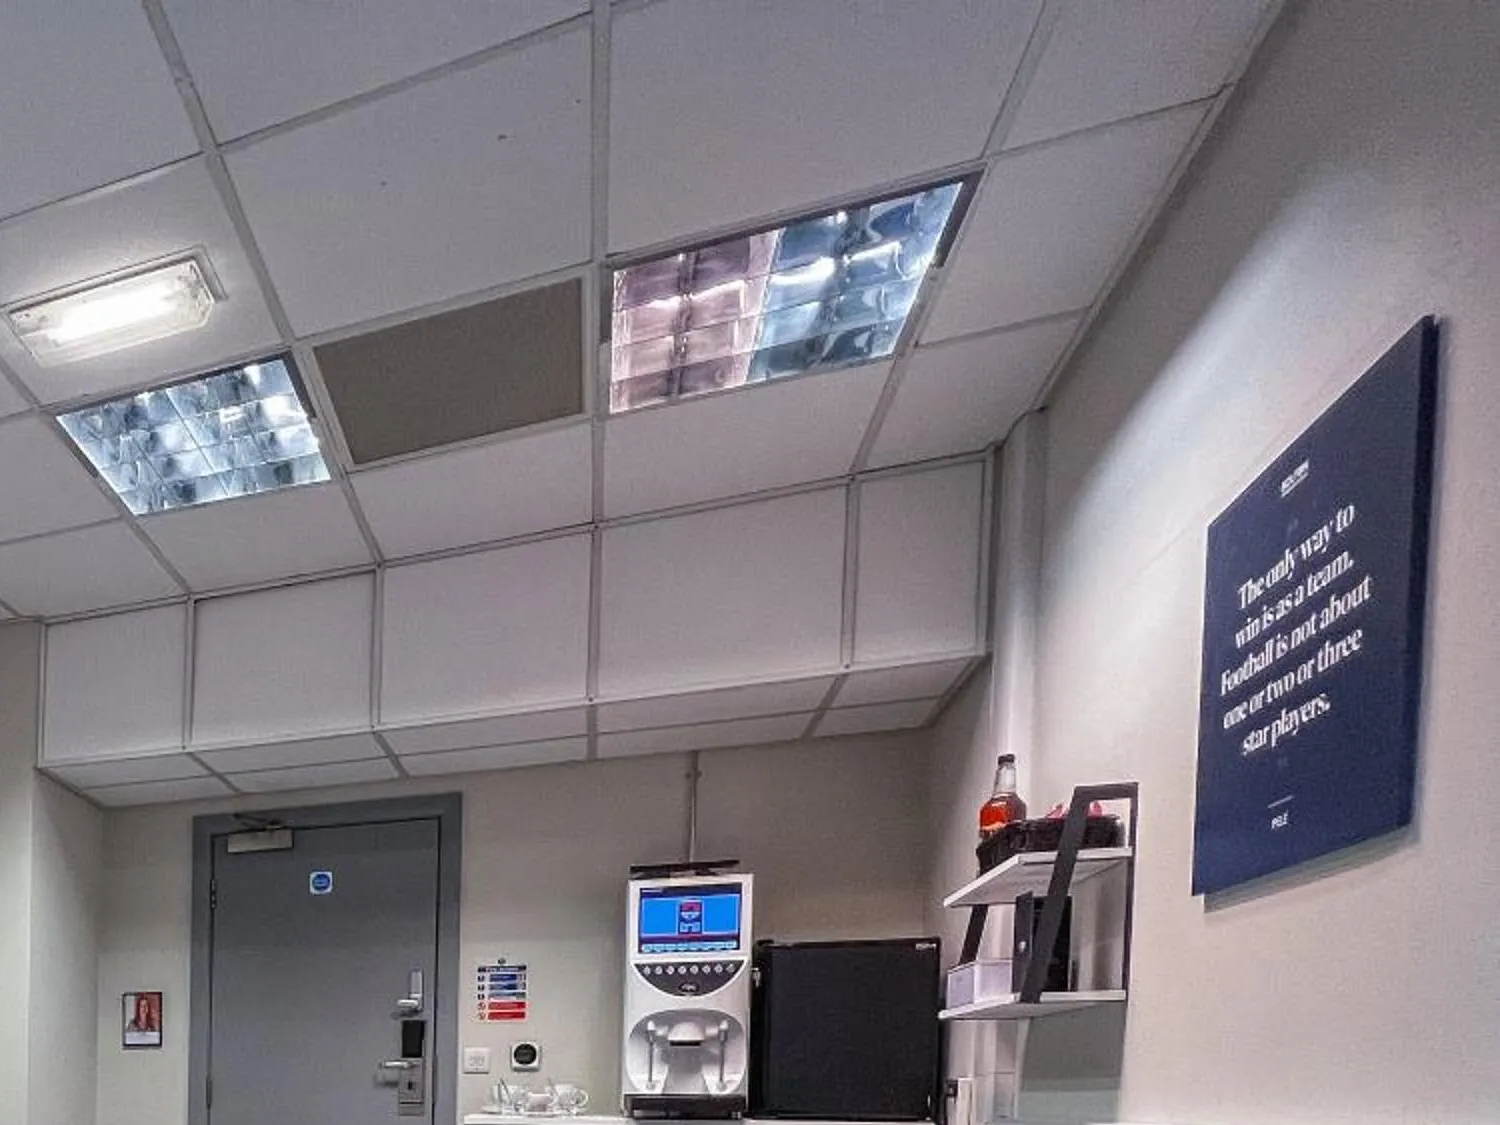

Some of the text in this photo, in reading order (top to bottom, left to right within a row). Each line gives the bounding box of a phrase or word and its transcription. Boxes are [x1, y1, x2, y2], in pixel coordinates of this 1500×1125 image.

[1235, 551, 1354, 649] win is as a team.
[1237, 505, 1354, 609] The only way to
[1220, 575, 1372, 696] Football is not about
[1223, 628, 1363, 729] one or two or three
[1243, 693, 1331, 756] star players.
